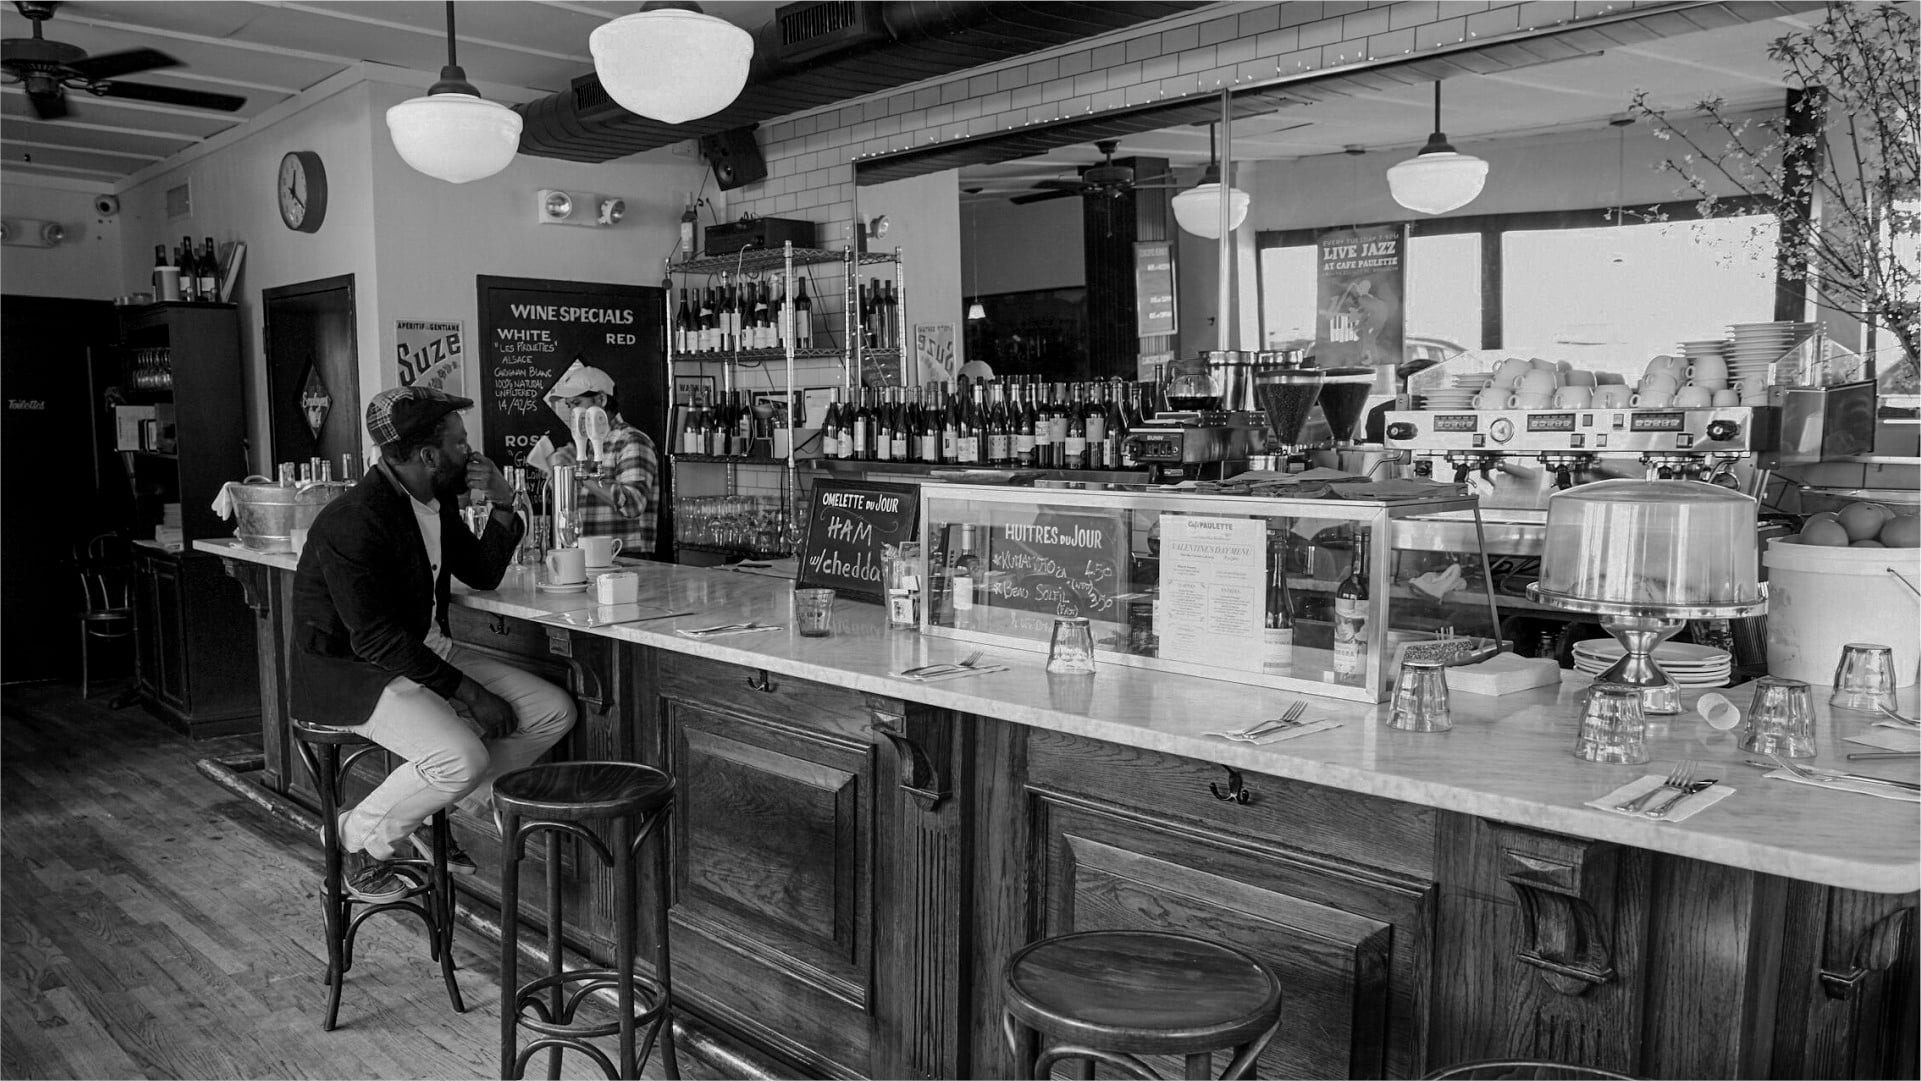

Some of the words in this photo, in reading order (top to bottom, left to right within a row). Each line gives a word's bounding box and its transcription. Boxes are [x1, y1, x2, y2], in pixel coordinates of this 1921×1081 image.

[1323, 245, 1357, 260] LIVE
[1361, 240, 1396, 257] JAZZ
[1324, 262, 1334, 271] AT
[1336, 261, 1357, 270] CAFE
[1358, 257, 1398, 268] PAULETTE
[510, 304, 558, 321] WINE
[559, 306, 634, 324] SPECIALS
[497, 328, 552, 342] WHITE
[606, 333, 636, 345] RED
[397, 333, 461, 387] Suze
[505, 430, 551, 447] ROS
[822, 492, 865, 510] OMELETTE
[875, 493, 899, 513] JOUR
[827, 516, 872, 547] HAM
[1005, 523, 1059, 545] HUITRES
[1071, 524, 1103, 549] JOUR
[1199, 522, 1233, 531] PAULETTE
[808, 548, 882, 582] w/chedda
